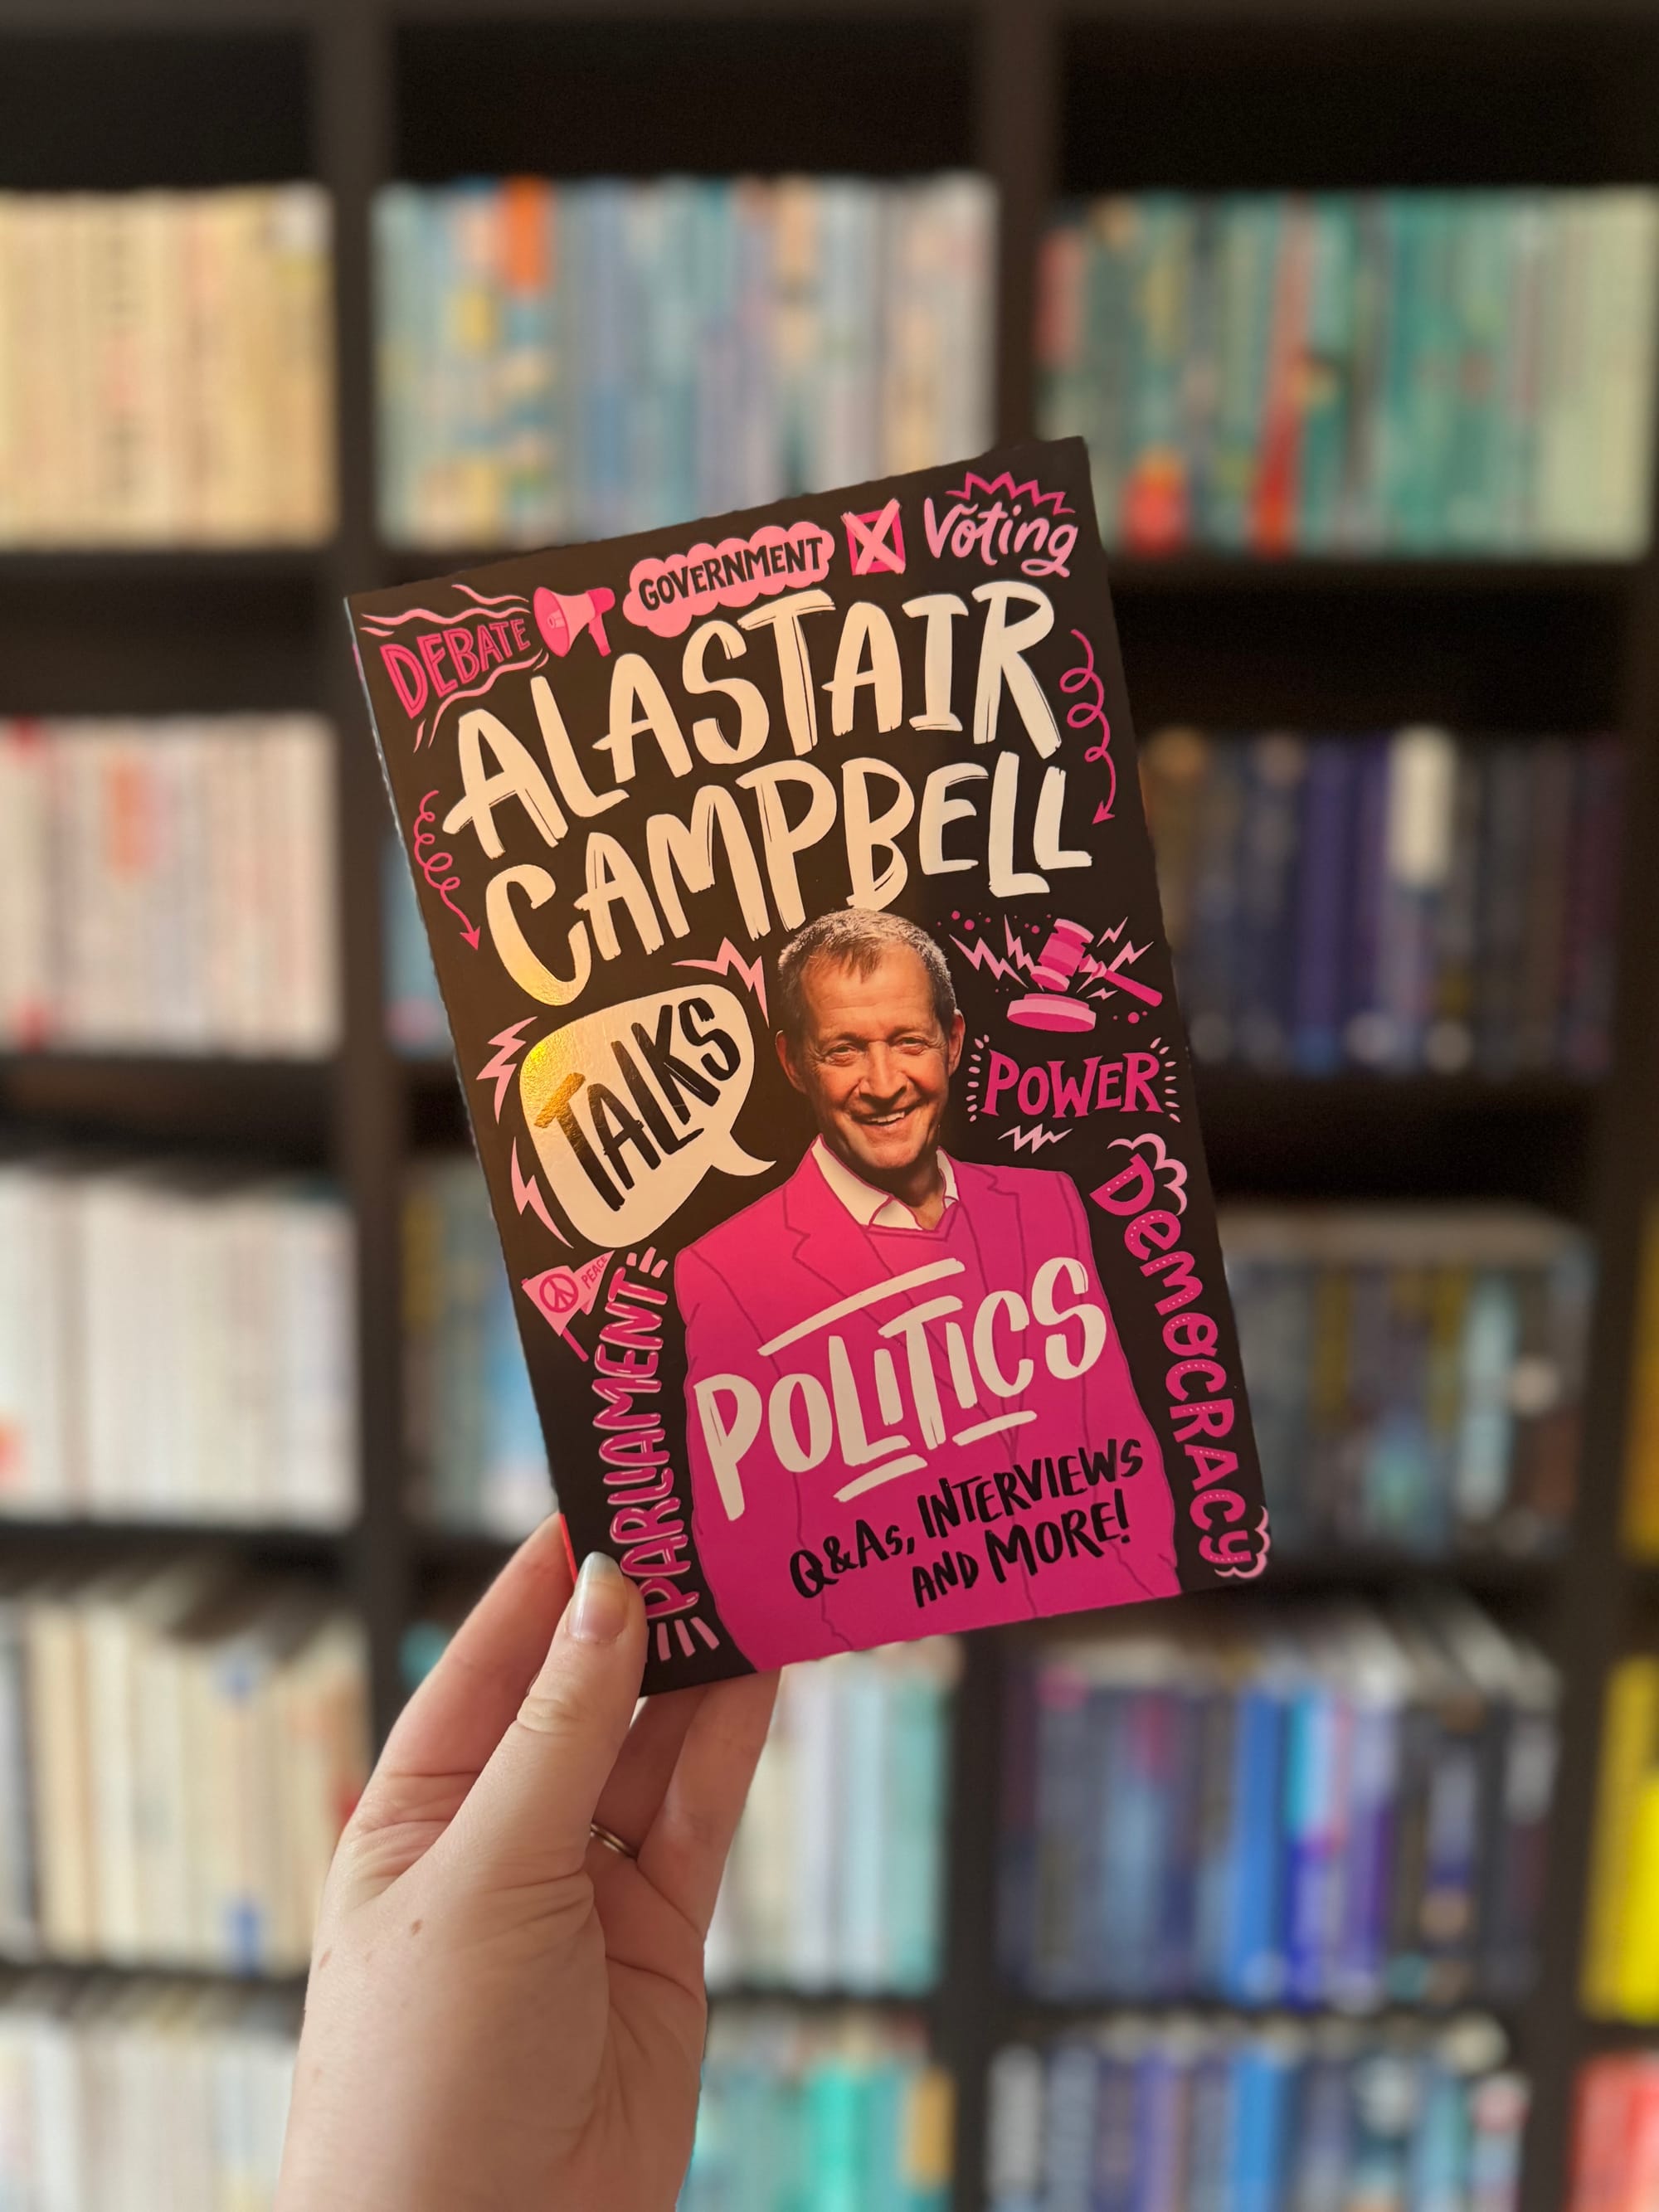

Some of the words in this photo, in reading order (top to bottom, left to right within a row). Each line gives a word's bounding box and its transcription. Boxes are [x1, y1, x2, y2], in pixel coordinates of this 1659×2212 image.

[639, 537, 823, 611] GOVERNMENT
[923, 498, 1078, 577] Voting
[380, 619, 531, 720] DEBATE
[442, 581, 1062, 859] ALASTAIR
[485, 751, 1092, 1006] CAMPBELL
[535, 998, 741, 1211] TALKS
[980, 1050, 1165, 1120] POWER
[581, 1256, 607, 1290] PEACE
[591, 1267, 699, 1620] PARLIAMENT
[917, 1438, 1144, 1539] INTERVIEWS
[913, 1551, 979, 1608] AND
[985, 1488, 1131, 1582] MORE!
